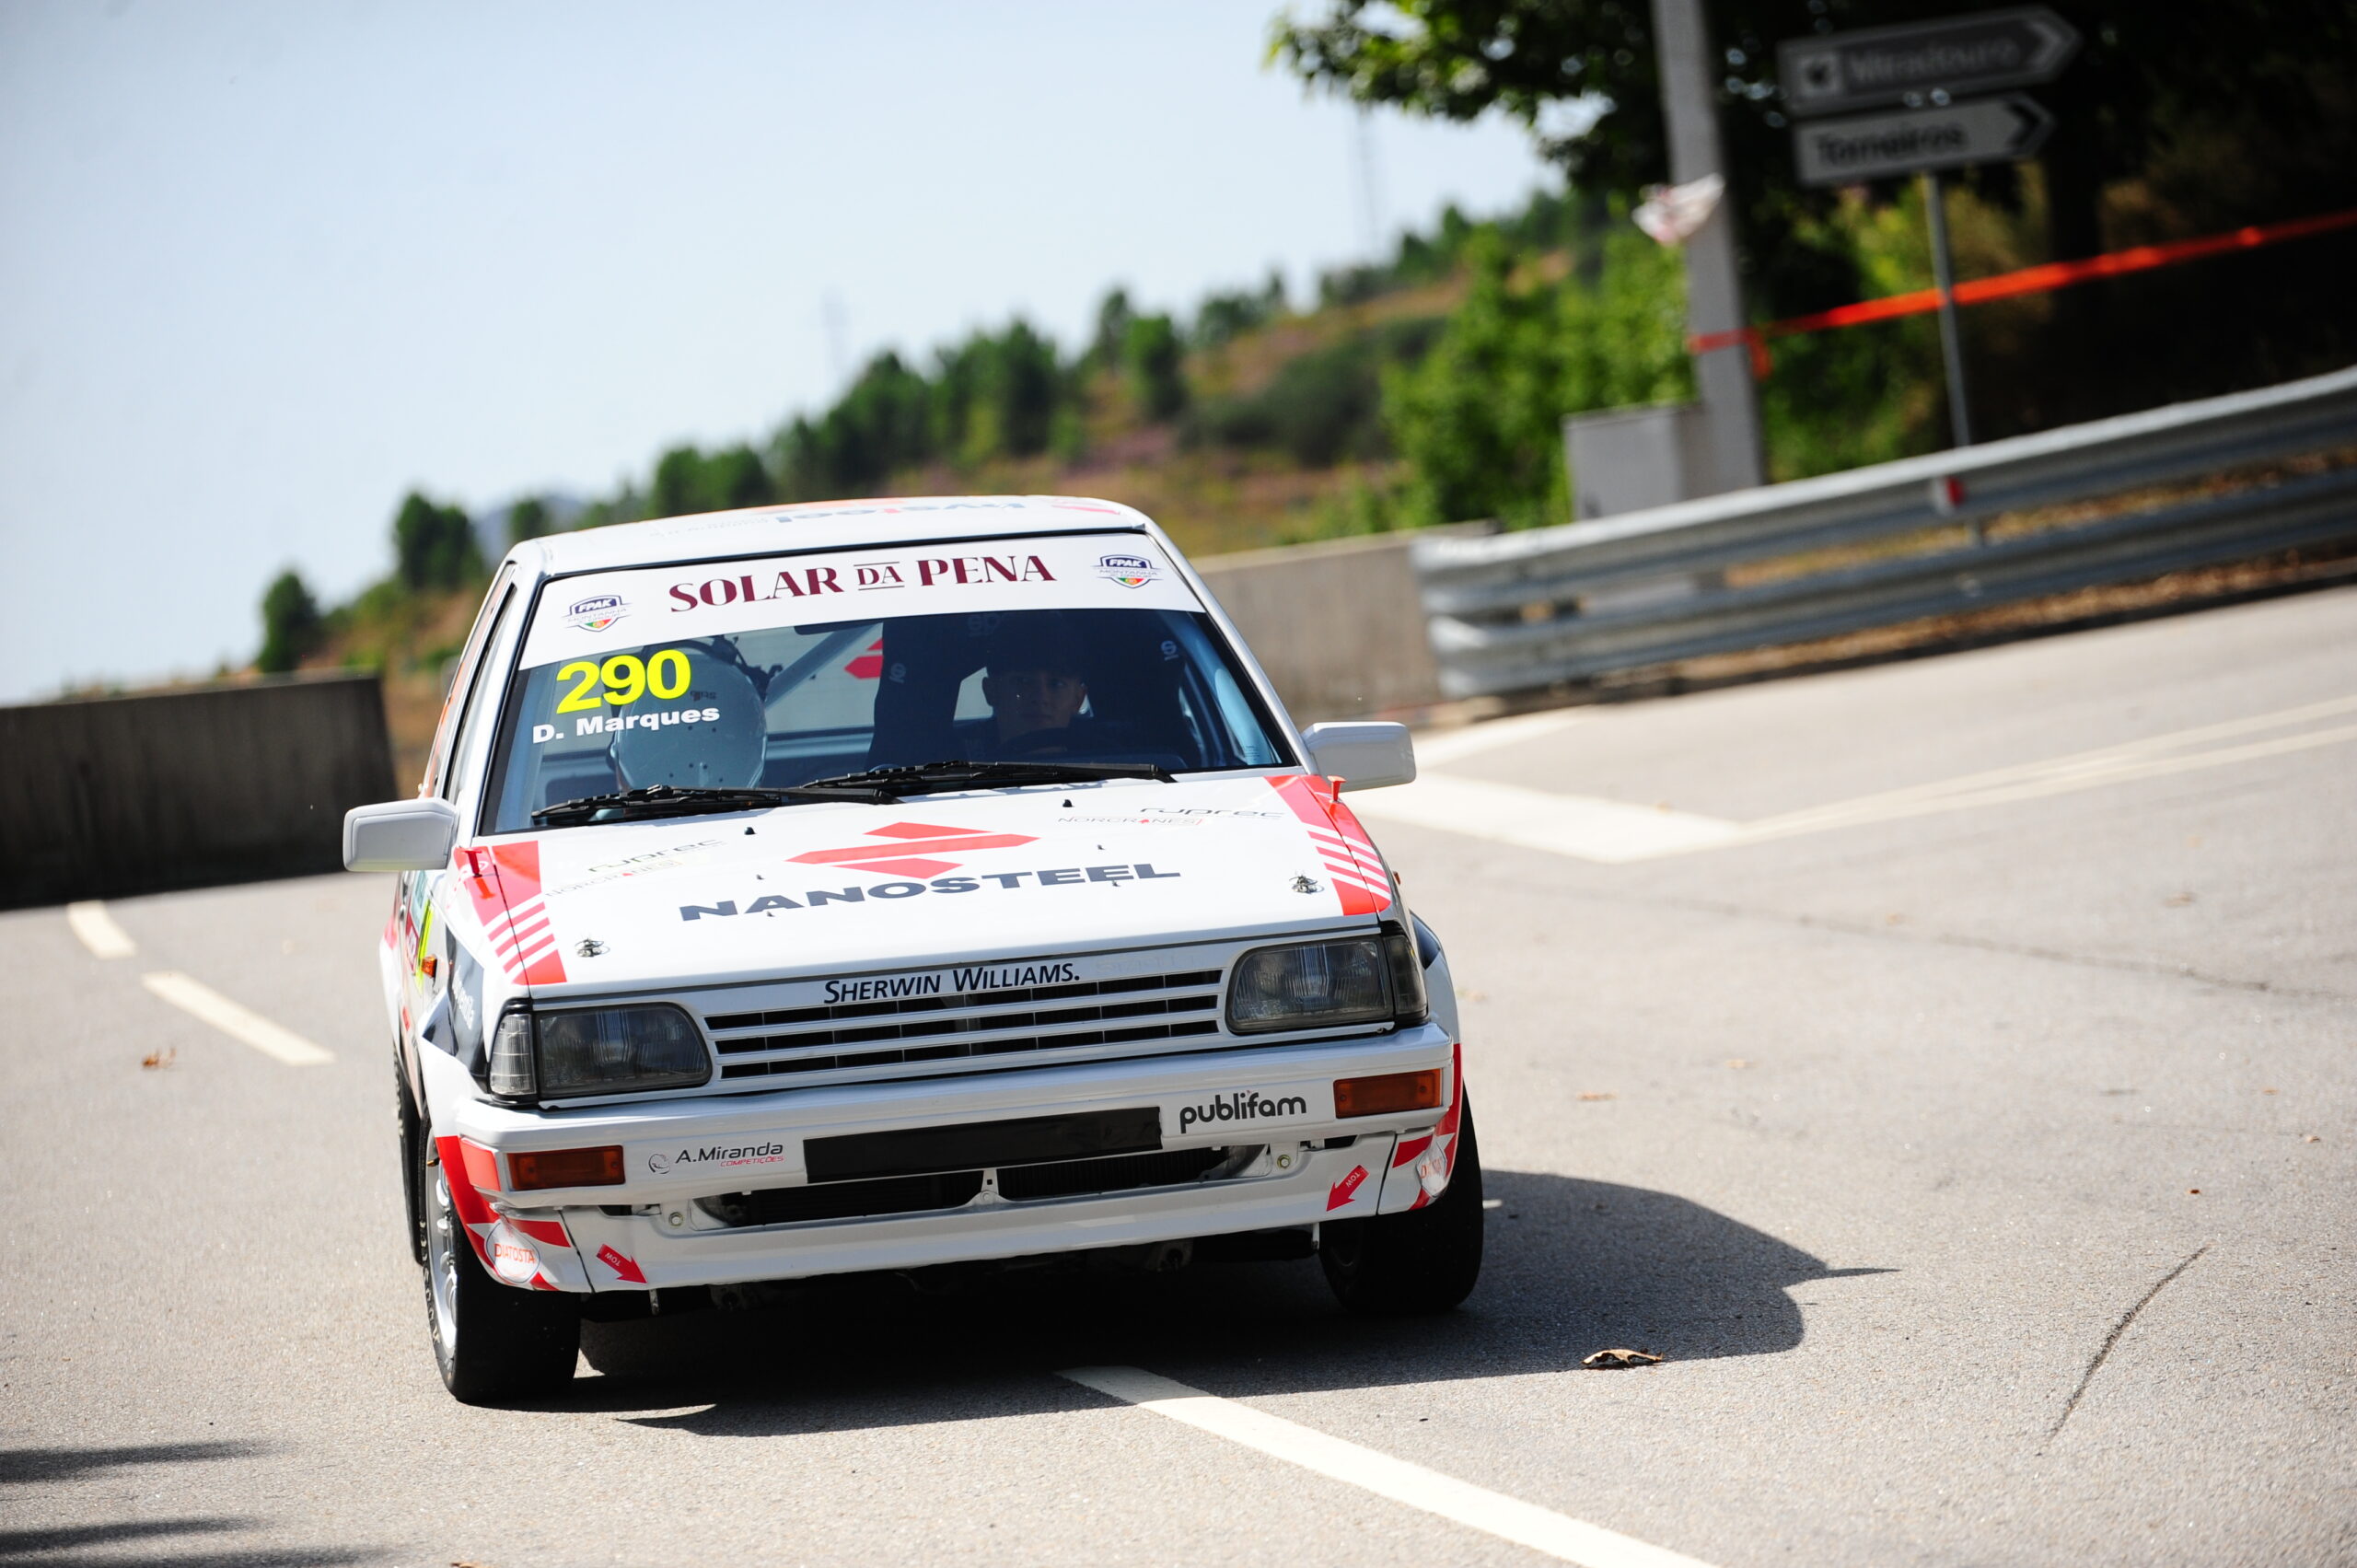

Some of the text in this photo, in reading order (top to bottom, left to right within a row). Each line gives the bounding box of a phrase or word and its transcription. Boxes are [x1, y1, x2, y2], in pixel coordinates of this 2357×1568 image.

[1109, 558, 1142, 567] FPAK
[668, 555, 1057, 612] SOLAR DA PENA
[578, 598, 613, 613] FPAK
[556, 649, 691, 714] 290
[532, 707, 720, 743] D. Marques
[679, 864, 1180, 921] NANOSTEEL
[824, 974, 941, 1004] SHERWIN
[1179, 1091, 1306, 1133] publifam
[675, 1142, 784, 1165] A.Miranda
[1345, 1171, 1361, 1188] TOW
[494, 1243, 536, 1264] DIATOSTA
[604, 1252, 621, 1267] TOW
